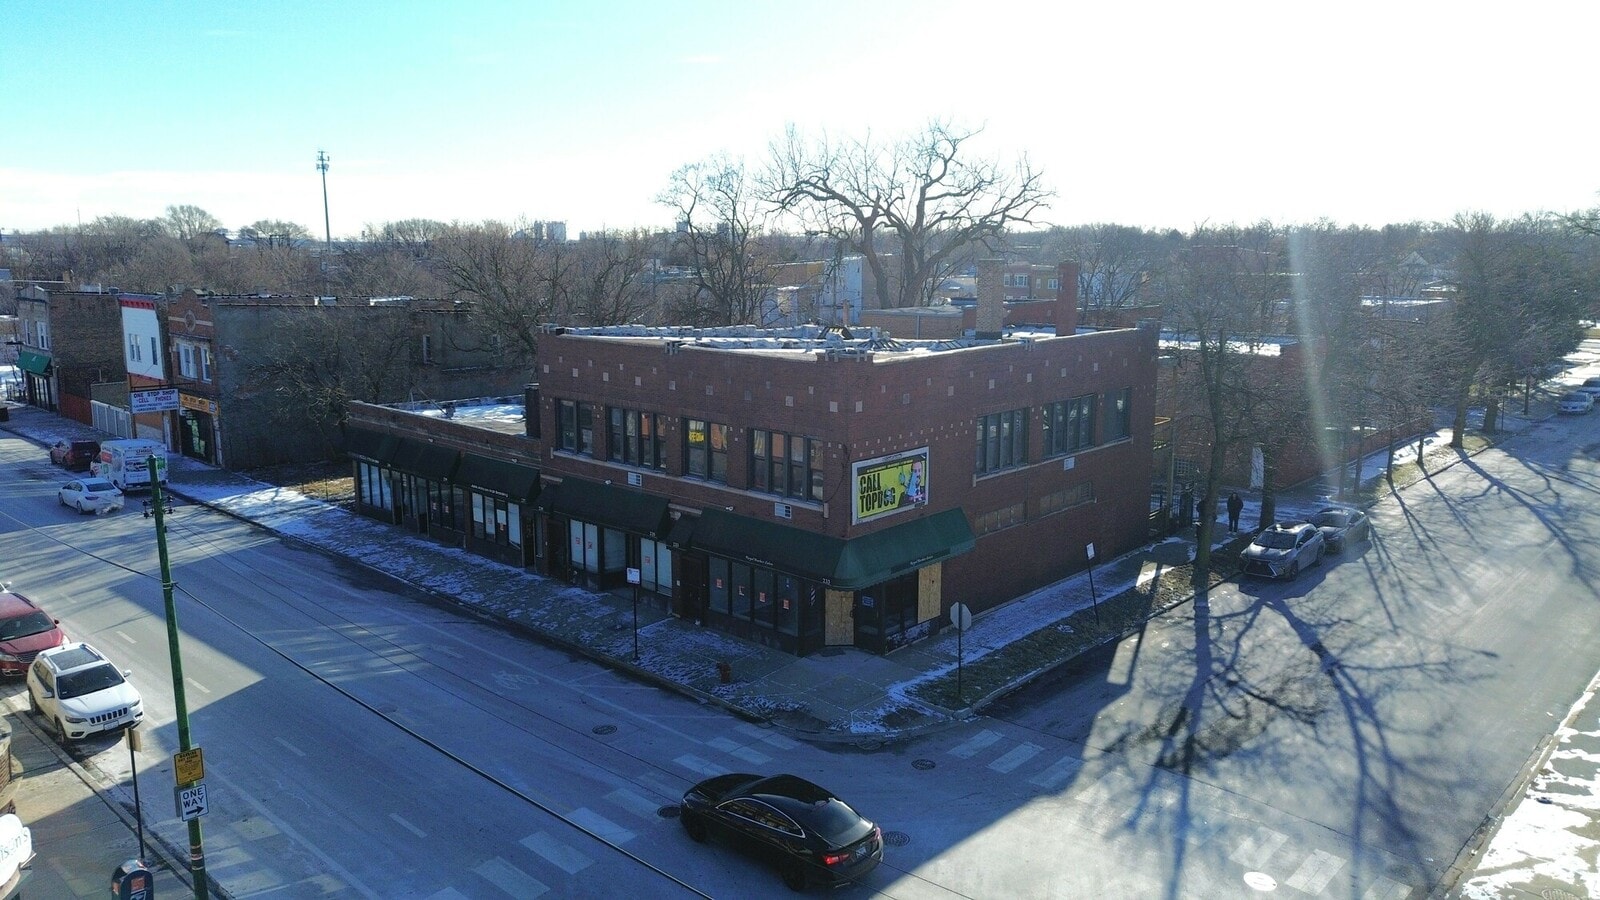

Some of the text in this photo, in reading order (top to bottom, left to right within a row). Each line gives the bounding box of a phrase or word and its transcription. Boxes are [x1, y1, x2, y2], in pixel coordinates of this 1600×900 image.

[860, 472, 881, 495] CALL
[183, 787, 204, 800] ONE
[183, 796, 204, 809] WAY
